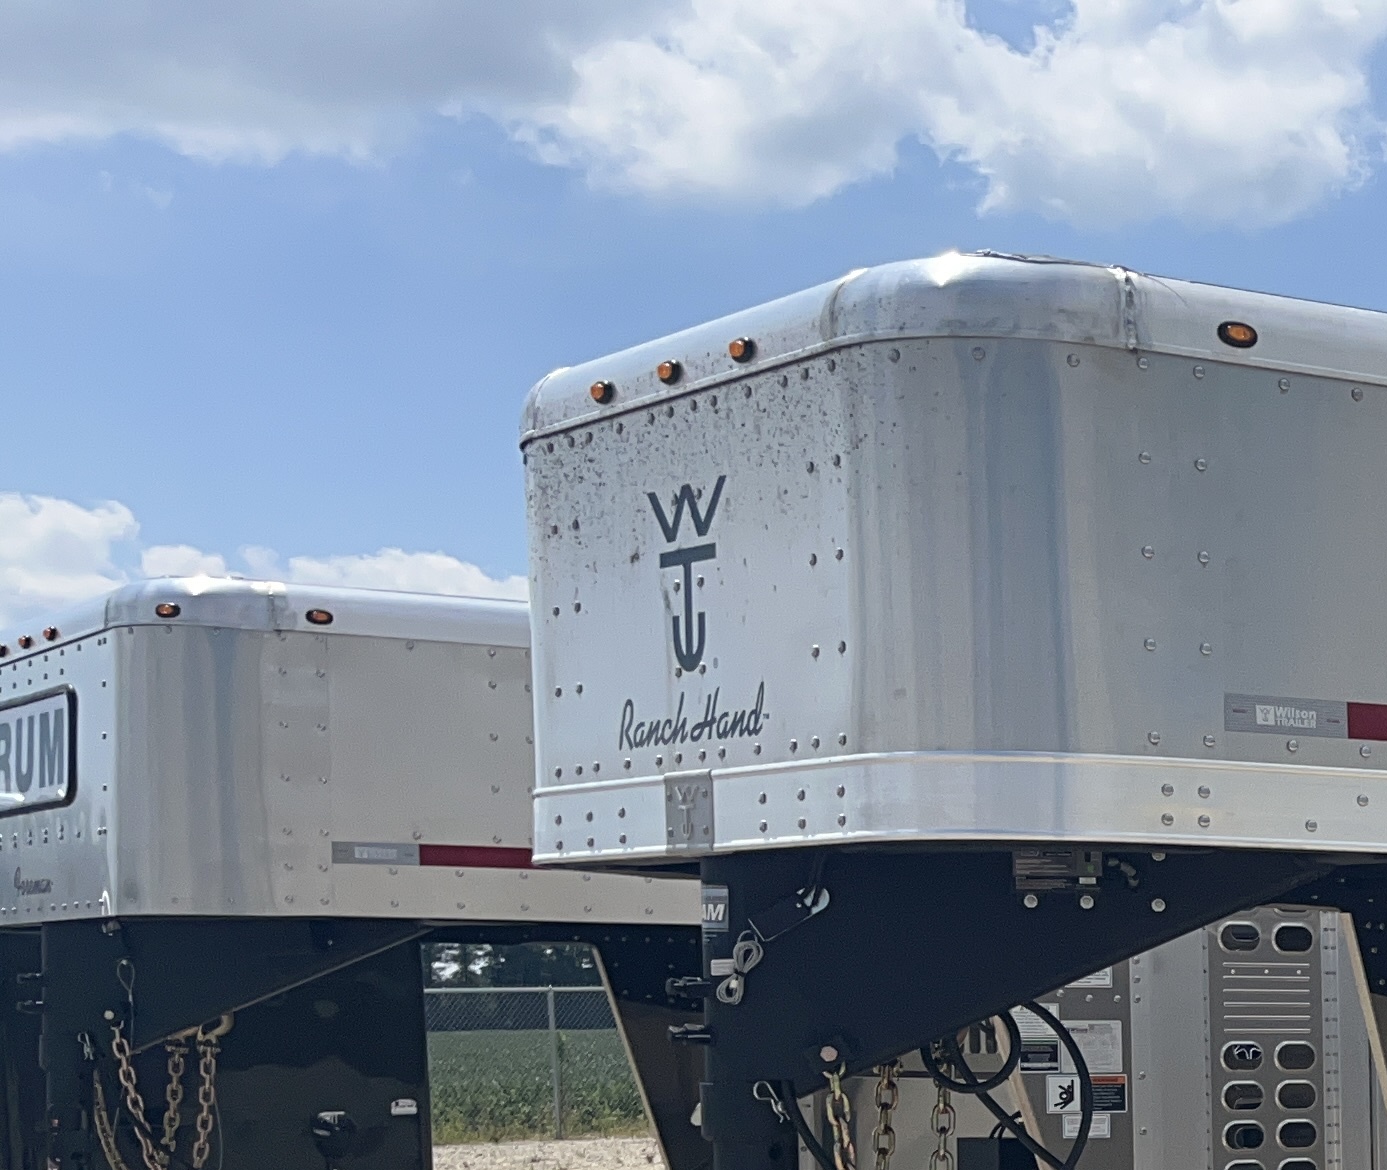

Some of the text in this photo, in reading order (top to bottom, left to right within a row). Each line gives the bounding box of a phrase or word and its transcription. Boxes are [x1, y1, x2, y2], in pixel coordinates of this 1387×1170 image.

[618, 681, 765, 751] Ranch Hand
[1275, 706, 1317, 720] Wilson
[1276, 717, 1317, 729] TRAILER
